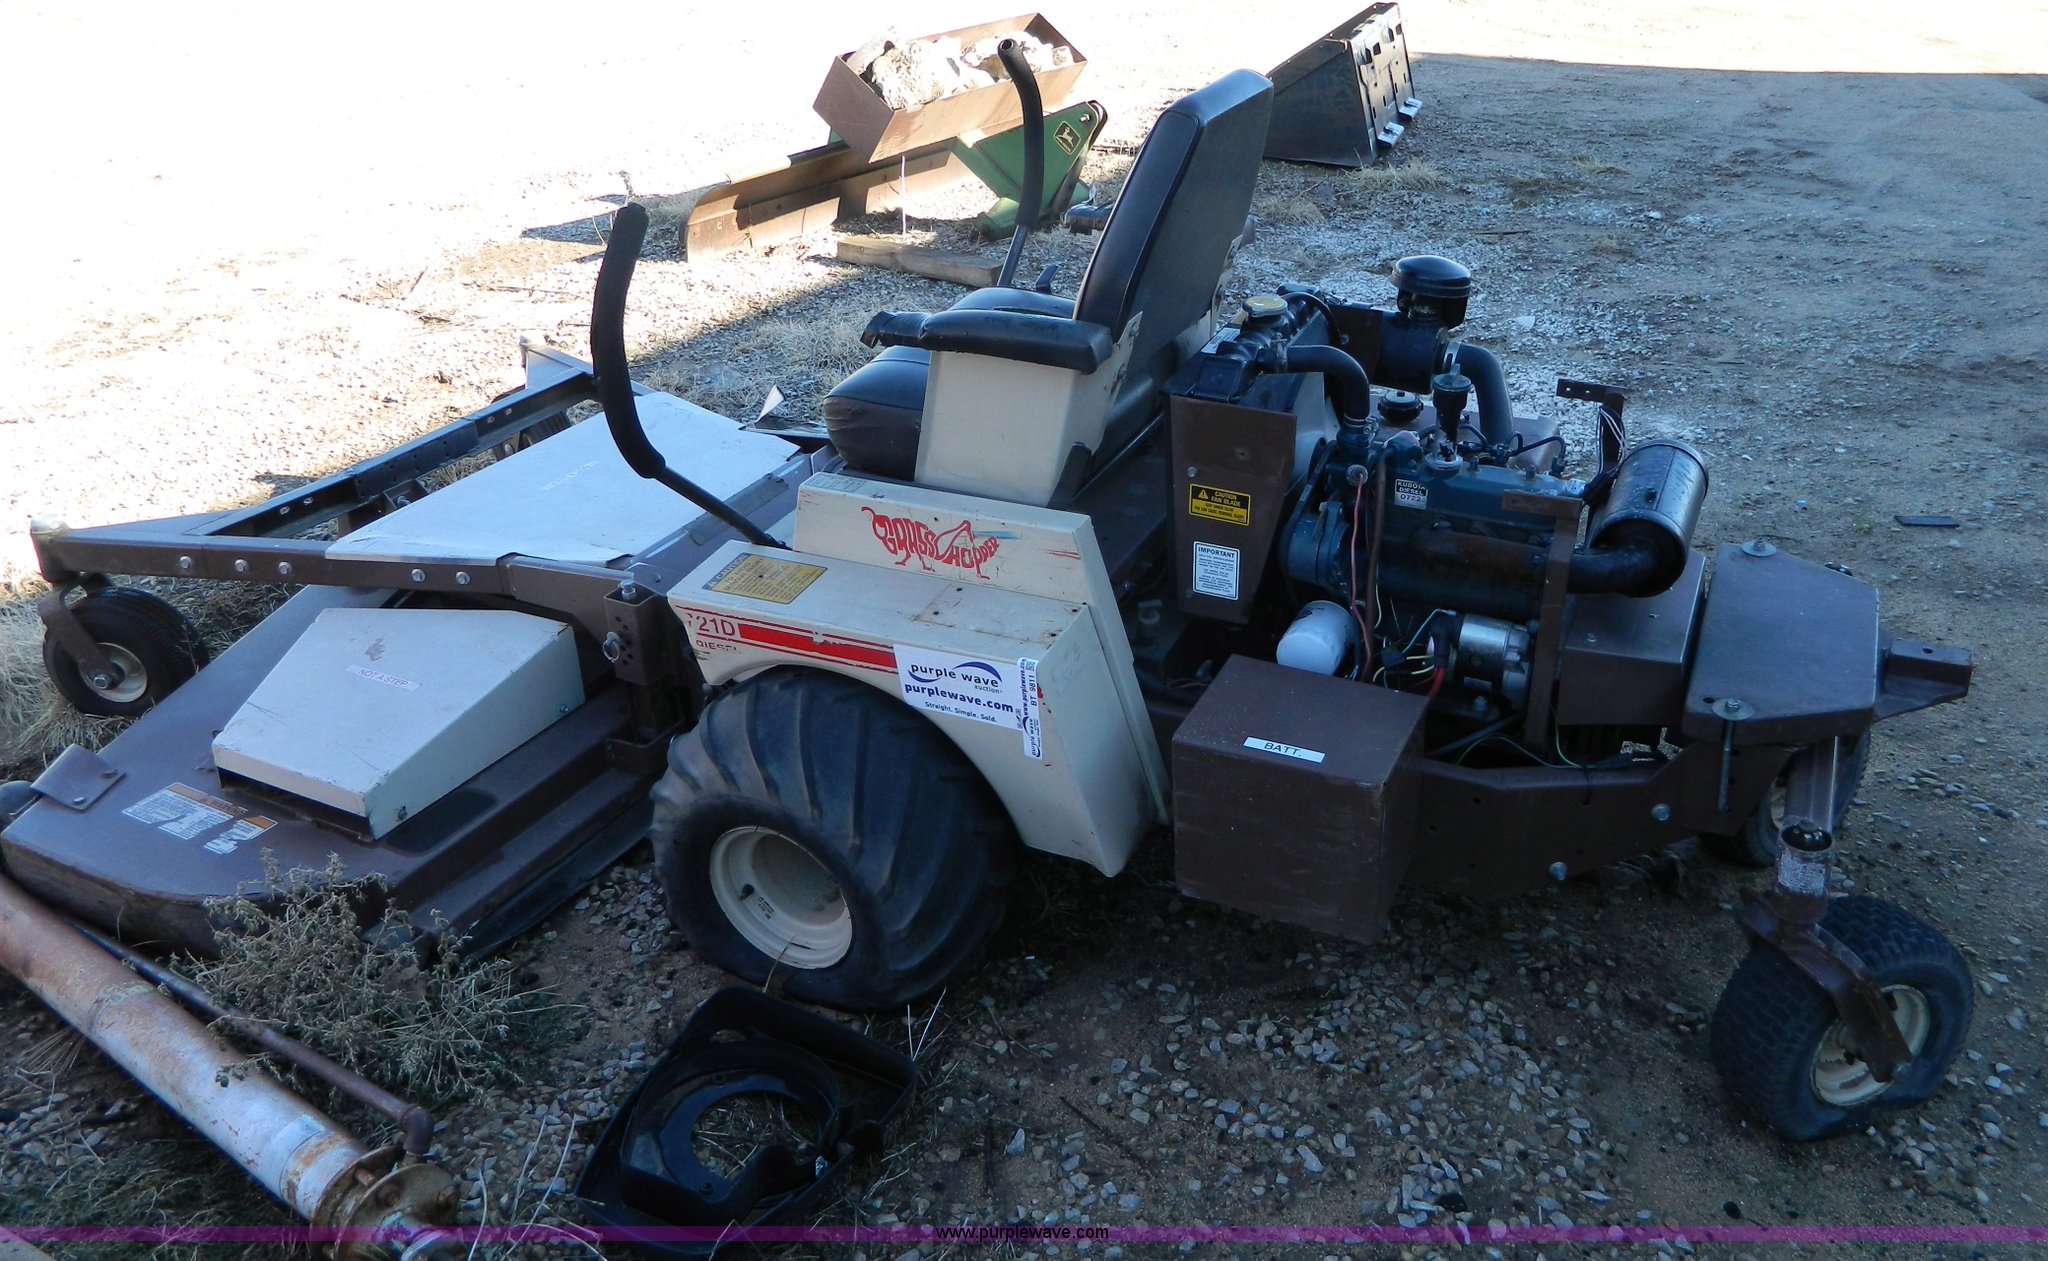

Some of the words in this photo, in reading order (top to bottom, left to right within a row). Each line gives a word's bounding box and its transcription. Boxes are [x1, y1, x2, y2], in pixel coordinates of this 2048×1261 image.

[1397, 481, 1426, 490] KUBOTA
[1399, 487, 1424, 495] DIESEL
[1214, 491, 1237, 500] CAUTION
[1400, 494, 1421, 502] D722
[1223, 498, 1241, 507] BLADE
[1198, 547, 1235, 558] IMPORTANT
[716, 554, 748, 580] CAUTION
[358, 669, 379, 678] NOT
[384, 676, 409, 686] STEP
[911, 664, 956, 679] purple
[961, 673, 999, 687] wave
[1028, 674, 1036, 692] 9811
[974, 684, 1000, 694] auction
[904, 683, 1014, 713] purplewave.com
[1030, 696, 1037, 707] BT
[924, 701, 953, 713] Straight.
[954, 707, 980, 719] Simple.
[980, 713, 998, 723] Sold.
[1264, 742, 1302, 757] BATT.
